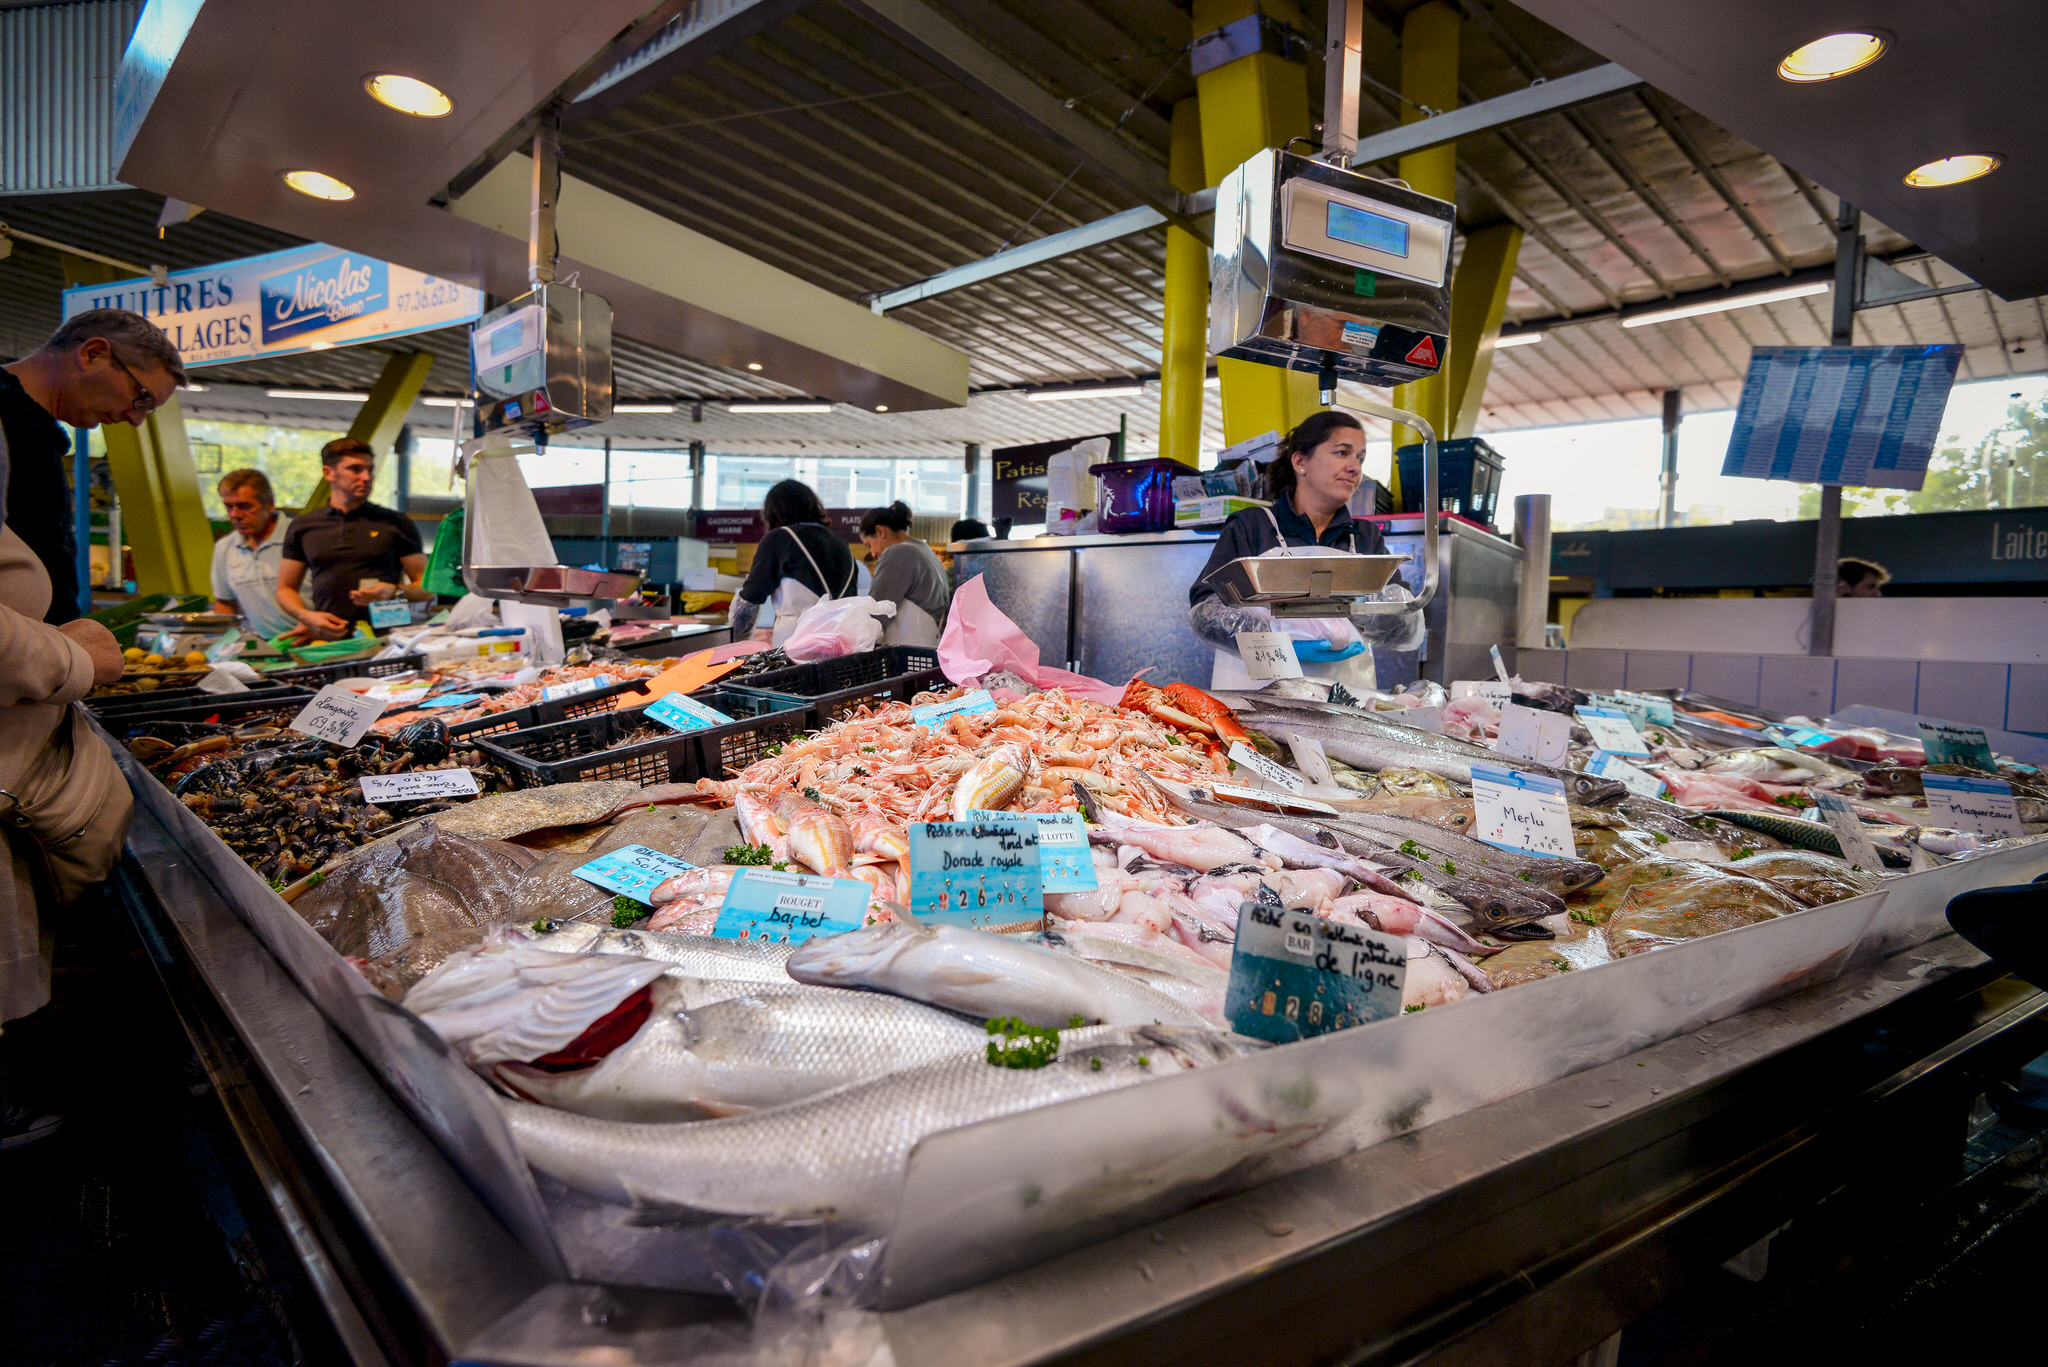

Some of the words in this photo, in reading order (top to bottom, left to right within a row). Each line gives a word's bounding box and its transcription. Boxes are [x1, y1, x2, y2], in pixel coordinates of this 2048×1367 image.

[275, 258, 371, 320] Nicolas
[996, 461, 1048, 480] Patis
[1992, 522, 2048, 560] Laite
[1503, 806, 1544, 827] Merlu
[1950, 804, 2012, 819] Maquereaux
[1046, 832, 1076, 841] LOTTE
[943, 850, 984, 870] Dorade
[991, 853, 1023, 872] royale
[780, 895, 822, 909] ROUGET
[1288, 935, 1311, 950] BAR
[1315, 944, 1340, 974] de
[1352, 951, 1400, 993] ligne
